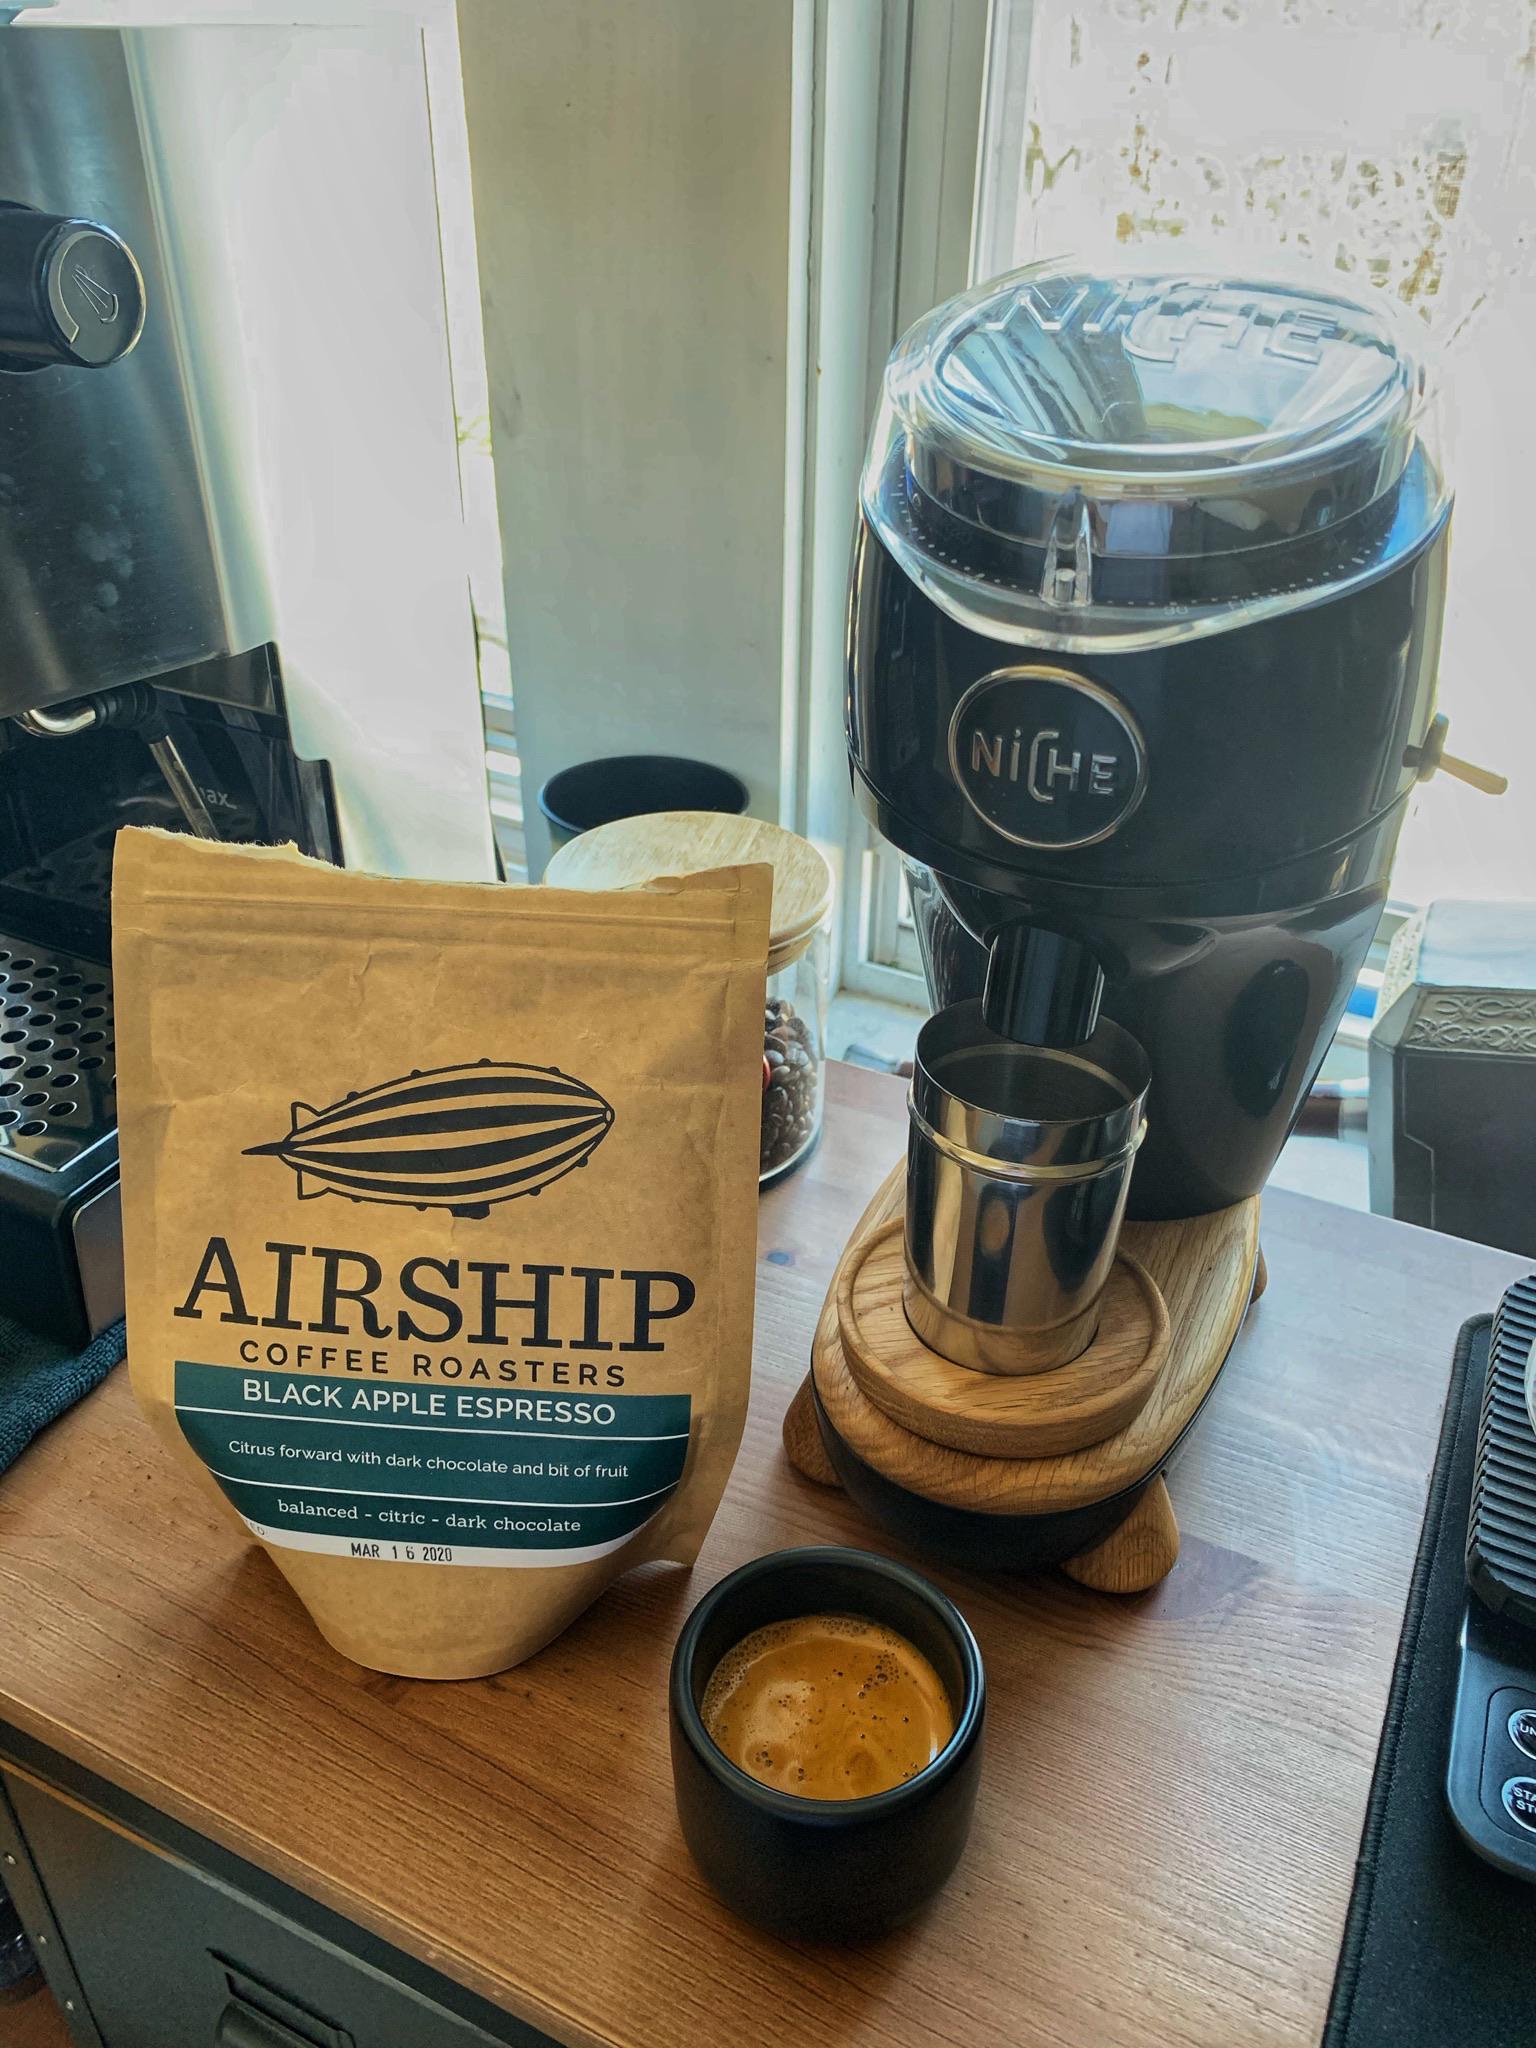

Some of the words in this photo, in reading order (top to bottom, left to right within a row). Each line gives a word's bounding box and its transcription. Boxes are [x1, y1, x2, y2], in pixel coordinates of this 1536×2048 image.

[174, 1236, 697, 1352] AIRSHIP
[239, 1340, 389, 1374] COFFEE
[412, 1353, 626, 1388] ROASTERS
[243, 1378, 344, 1409] BLACK
[351, 1388, 447, 1417] APPLE
[456, 1395, 616, 1426] ESPRESSO
[228, 1440, 276, 1457] Citrus
[279, 1444, 343, 1463] forward
[346, 1451, 382, 1466] with
[385, 1453, 422, 1469] dark
[426, 1456, 509, 1474] chocolate
[512, 1462, 544, 1477] and
[548, 1463, 570, 1478] bit
[574, 1464, 592, 1478] of
[595, 1464, 630, 1479] fruit
[277, 1498, 359, 1521] balanced
[378, 1510, 426, 1525] citric
[445, 1513, 487, 1530] dark
[493, 1516, 582, 1533] chocolate
[350, 1542, 380, 1558] MAR
[422, 1546, 453, 1562] 2020
